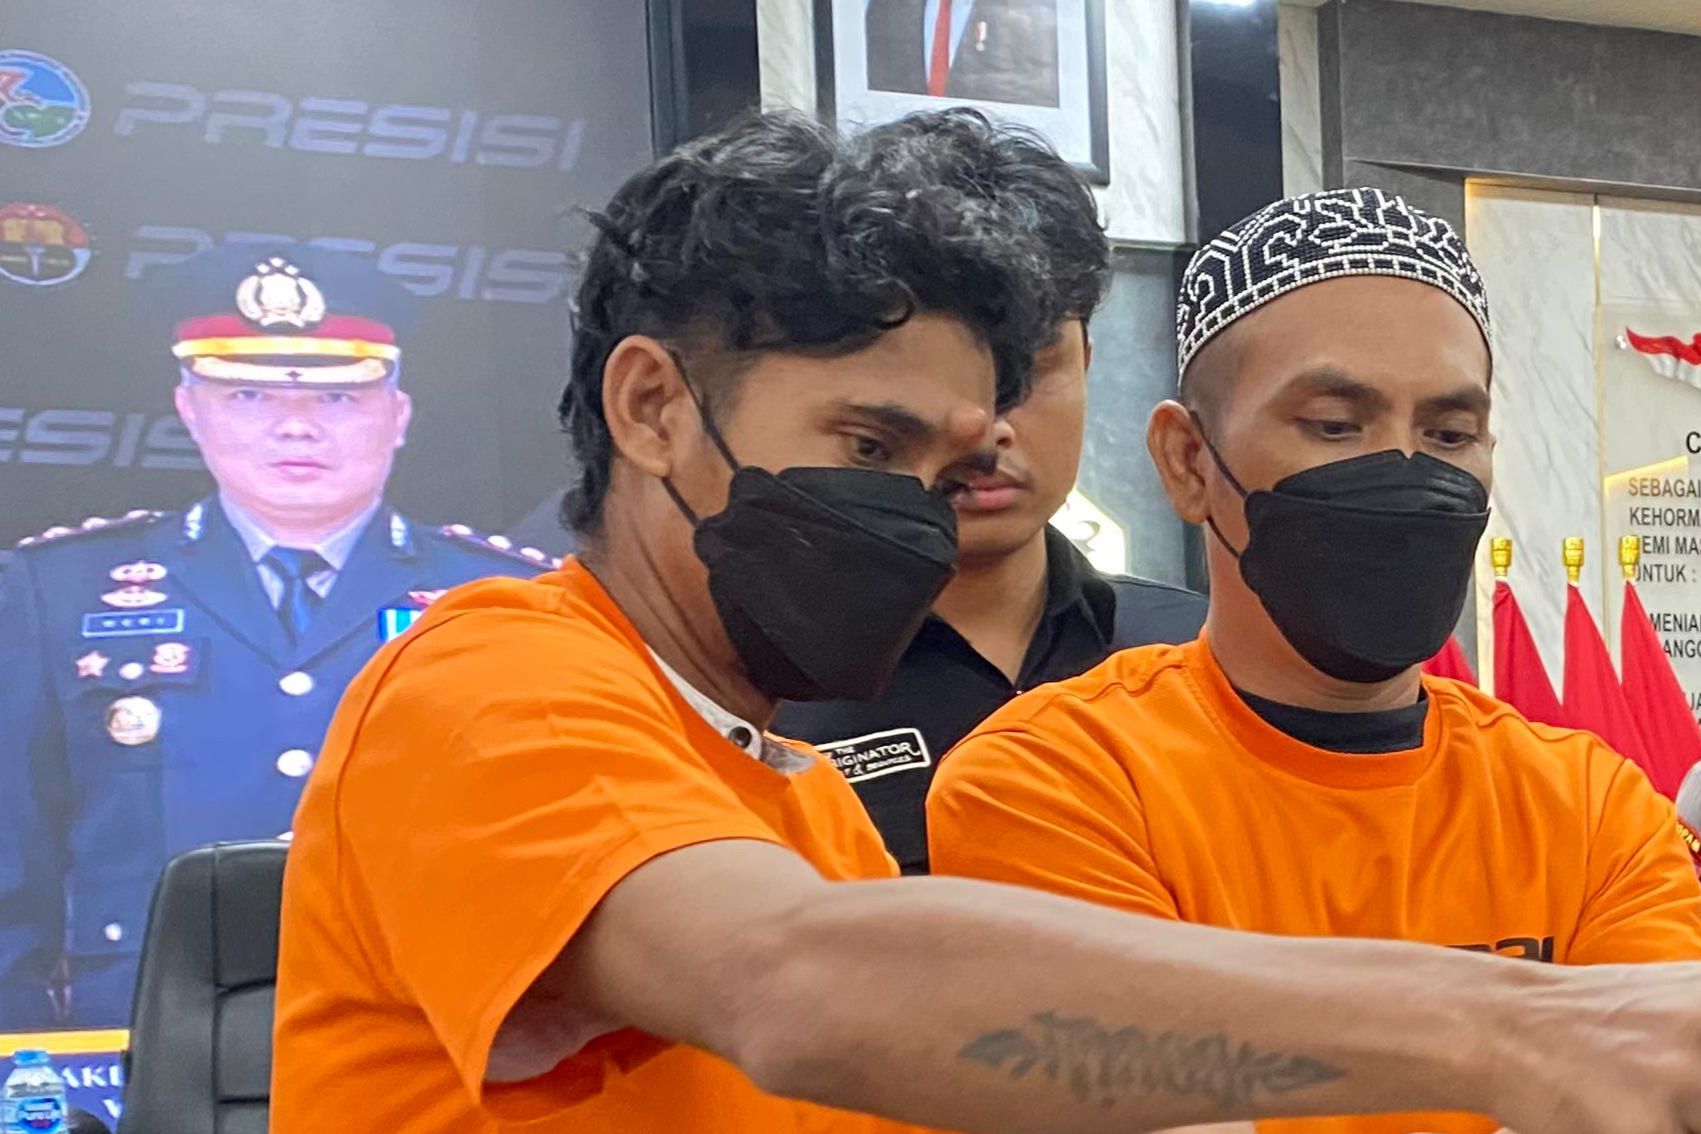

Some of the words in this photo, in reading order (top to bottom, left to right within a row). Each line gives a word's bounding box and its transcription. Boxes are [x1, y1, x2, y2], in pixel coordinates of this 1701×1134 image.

[114, 81, 587, 172] PRESISI
[1628, 477, 1700, 498] SEBAGAI
[1641, 535, 1670, 555] EMI
